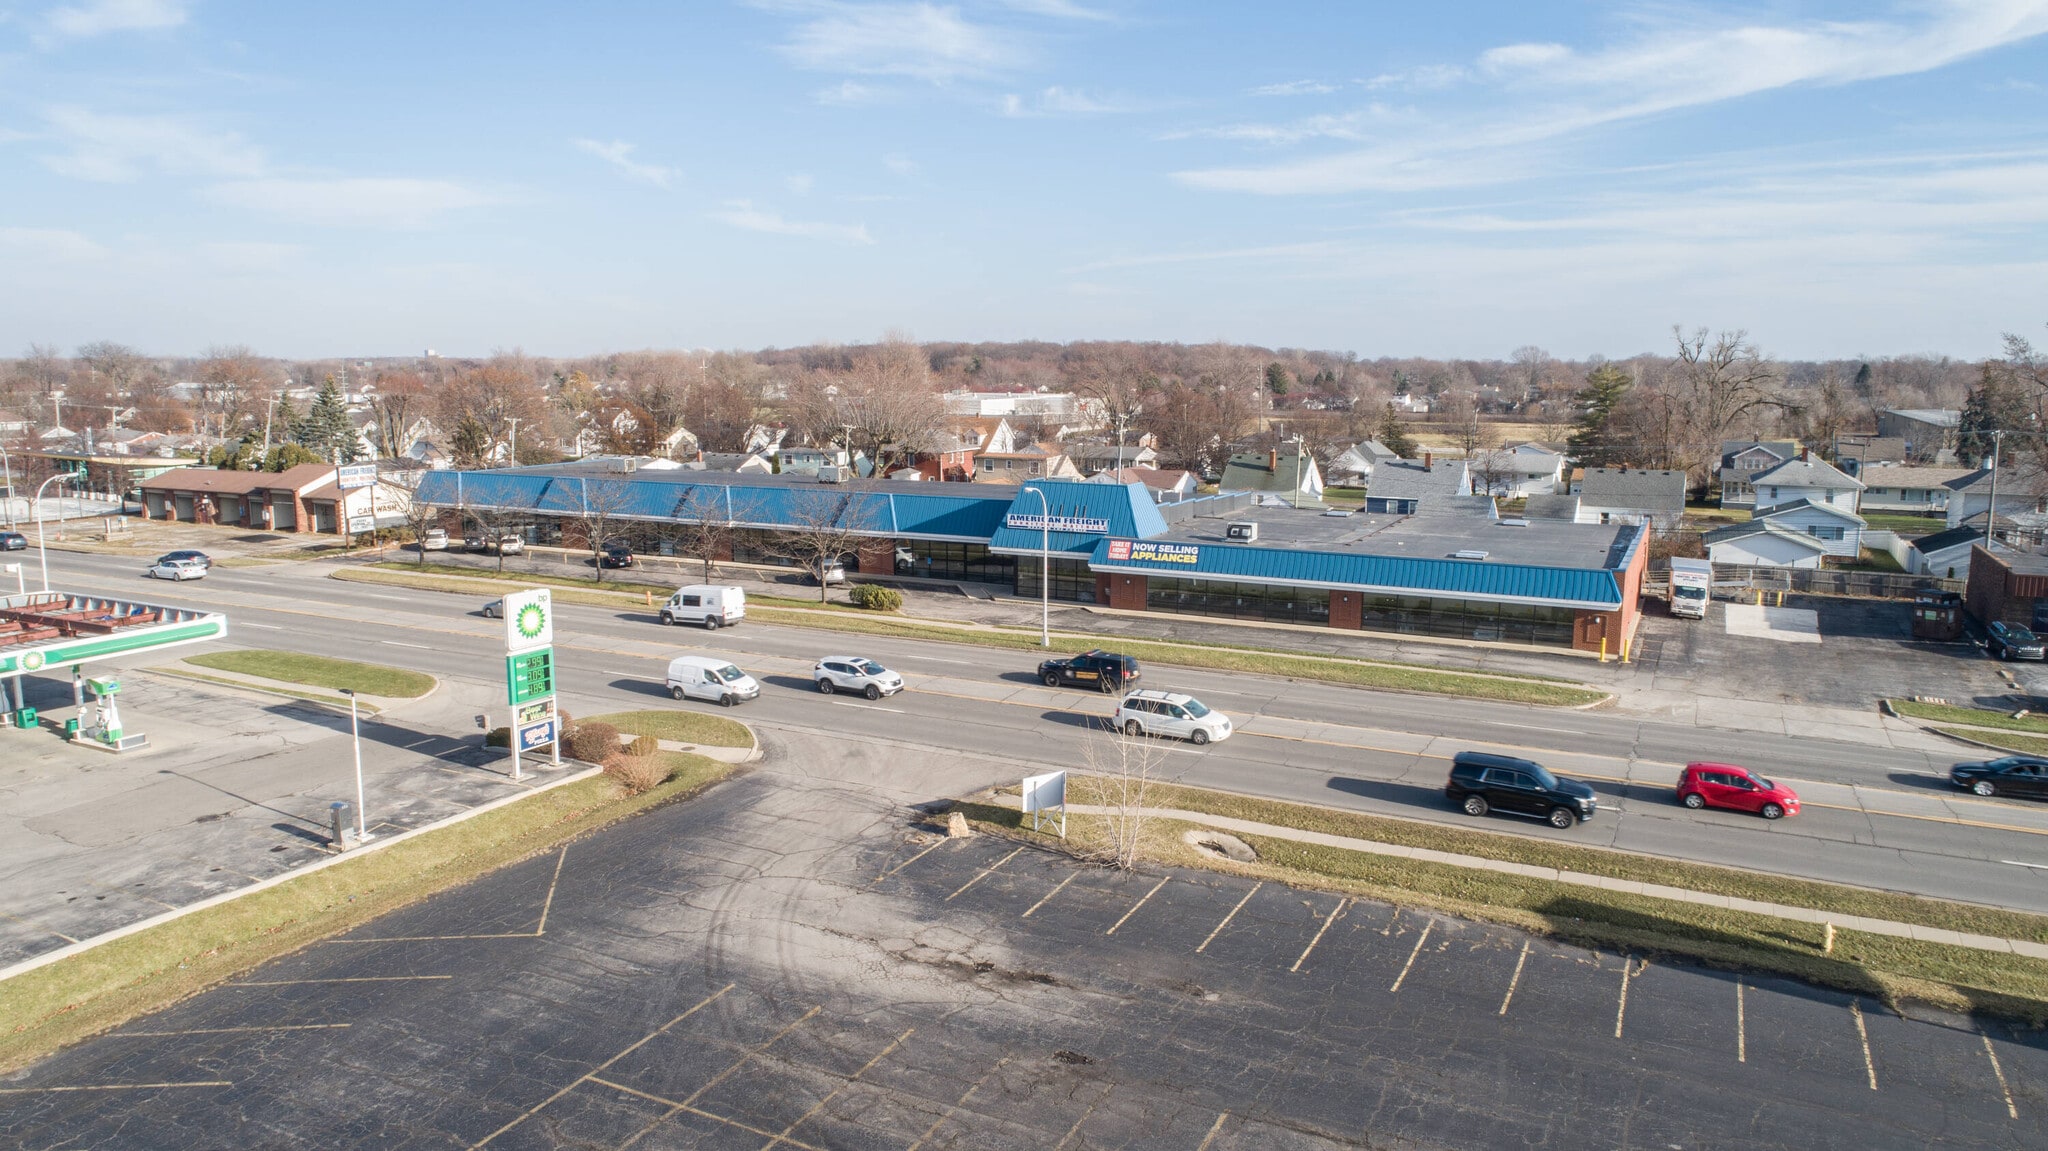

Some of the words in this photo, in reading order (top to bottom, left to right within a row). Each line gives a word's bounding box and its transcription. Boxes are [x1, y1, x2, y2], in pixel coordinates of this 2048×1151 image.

[376, 504, 397, 512] WASH
[1009, 514, 1061, 523] AMERICAN
[1063, 517, 1106, 526] FREIGHT
[1132, 543, 1157, 552] NOW
[1158, 545, 1199, 554] SELLING
[1131, 551, 1198, 563] APPLIANCES
